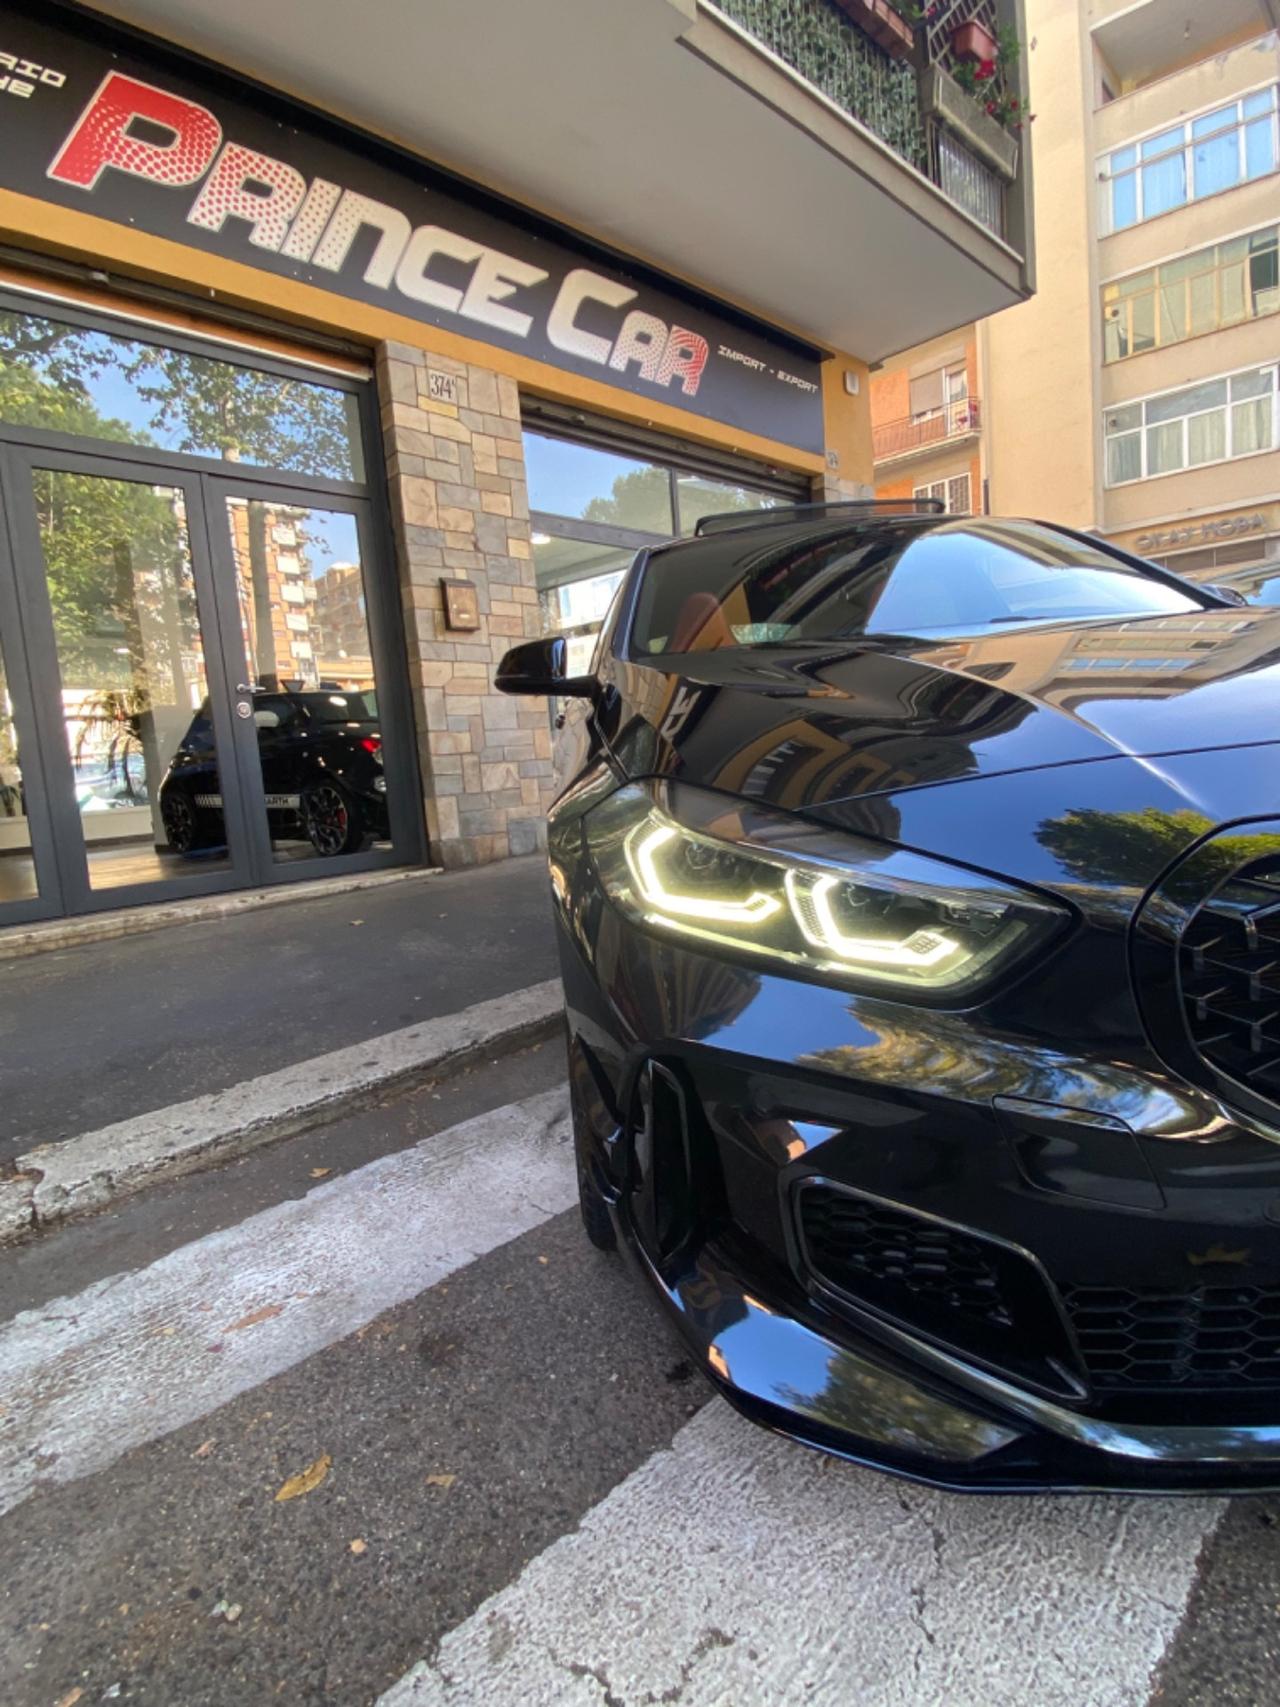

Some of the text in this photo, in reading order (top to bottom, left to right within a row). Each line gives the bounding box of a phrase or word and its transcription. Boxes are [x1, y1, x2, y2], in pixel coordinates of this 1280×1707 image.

[46, 70, 709, 396] PRINCE CAR
[718, 345, 767, 372] IMPORT
[777, 370, 818, 393] EXPORT
